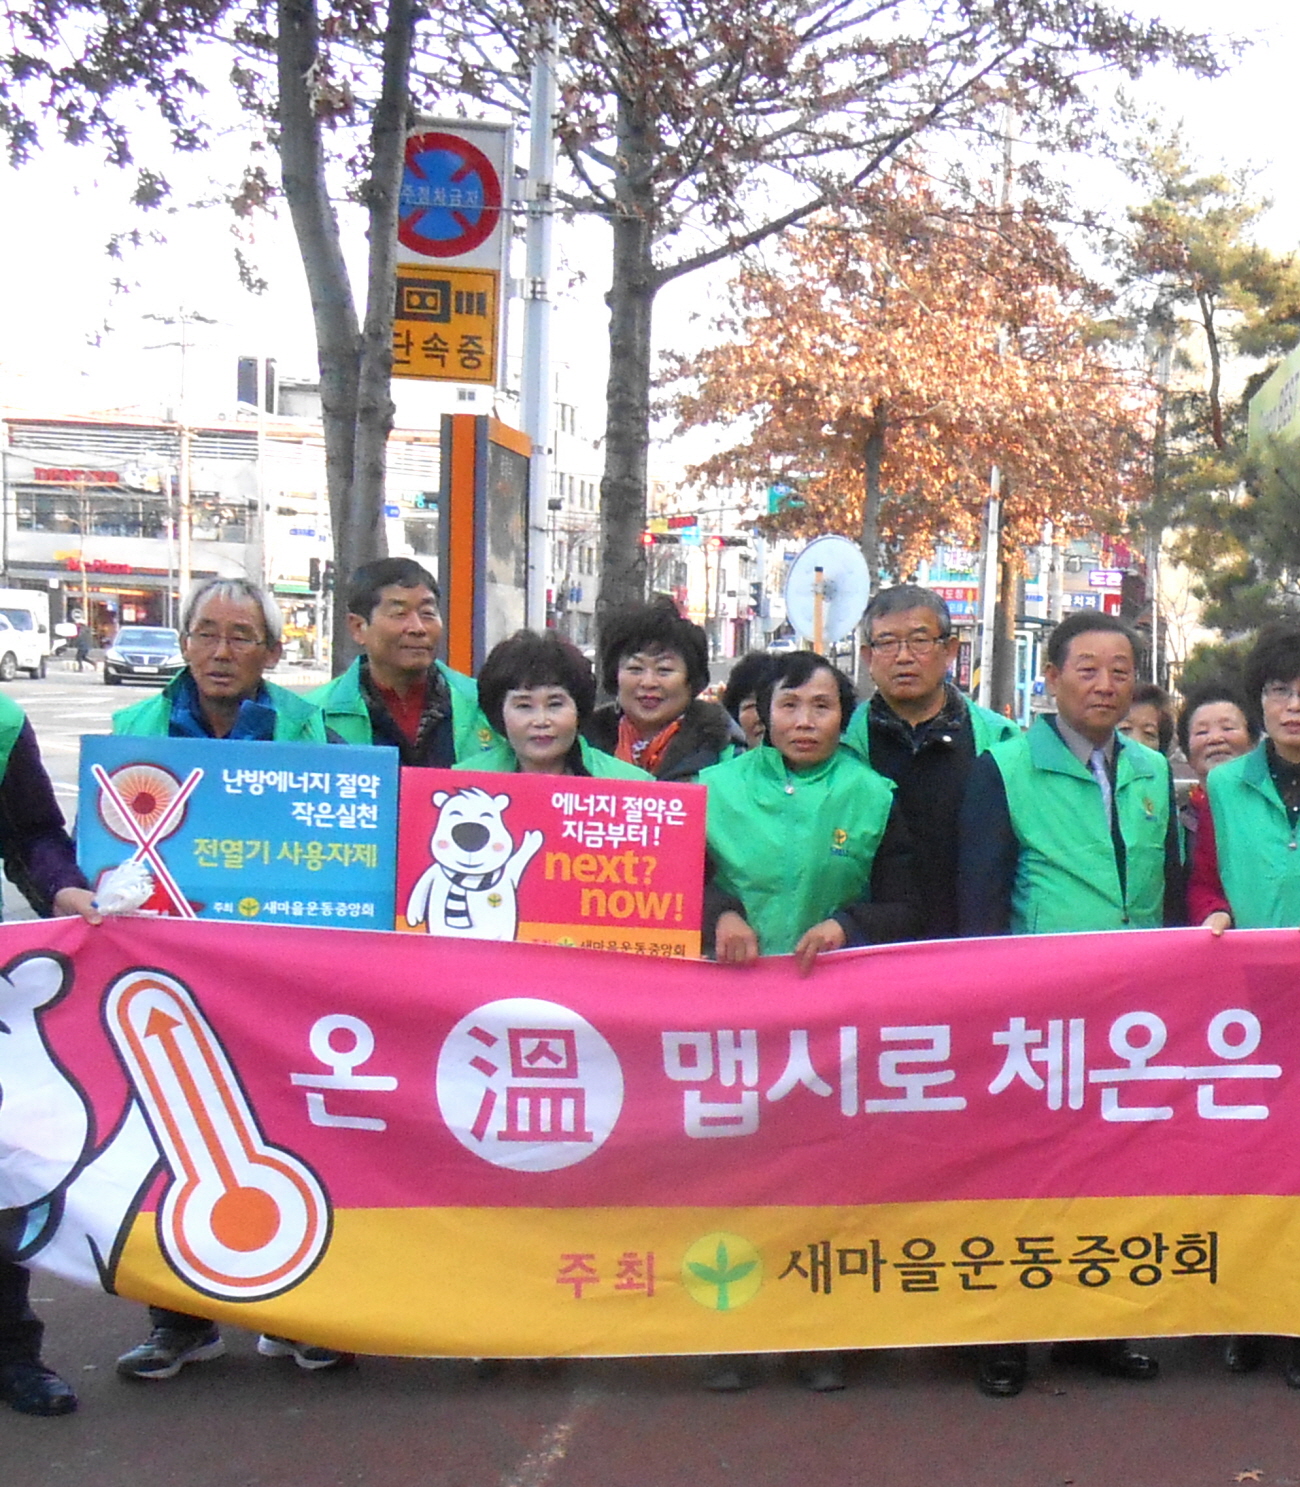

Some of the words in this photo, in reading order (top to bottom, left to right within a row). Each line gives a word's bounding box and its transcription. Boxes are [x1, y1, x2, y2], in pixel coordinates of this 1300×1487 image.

[401, 185, 479, 207] 주정차금지
[393, 327, 486, 370] 단속중
[223, 769, 330, 795] 난방에너지
[335, 772, 381, 799] 절약
[291, 801, 378, 829] 작은실천
[551, 792, 617, 818] 에너지
[622, 796, 688, 826] 절약은
[562, 820, 661, 849] 지금부터!
[193, 838, 270, 869] 전열기
[277, 841, 379, 872] 사용자제
[544, 850, 658, 885] next?
[213, 902, 233, 914] 주최
[263, 900, 375, 917] 새마을운동중앙회
[580, 888, 684, 922] now!
[290, 1014, 398, 1132] 온
[661, 1025, 968, 1139] 맵시로
[988, 1008, 1283, 1123] 체온은
[554, 1249, 656, 1299] 주최
[777, 1230, 1220, 1295] 새마을운동중앙회
